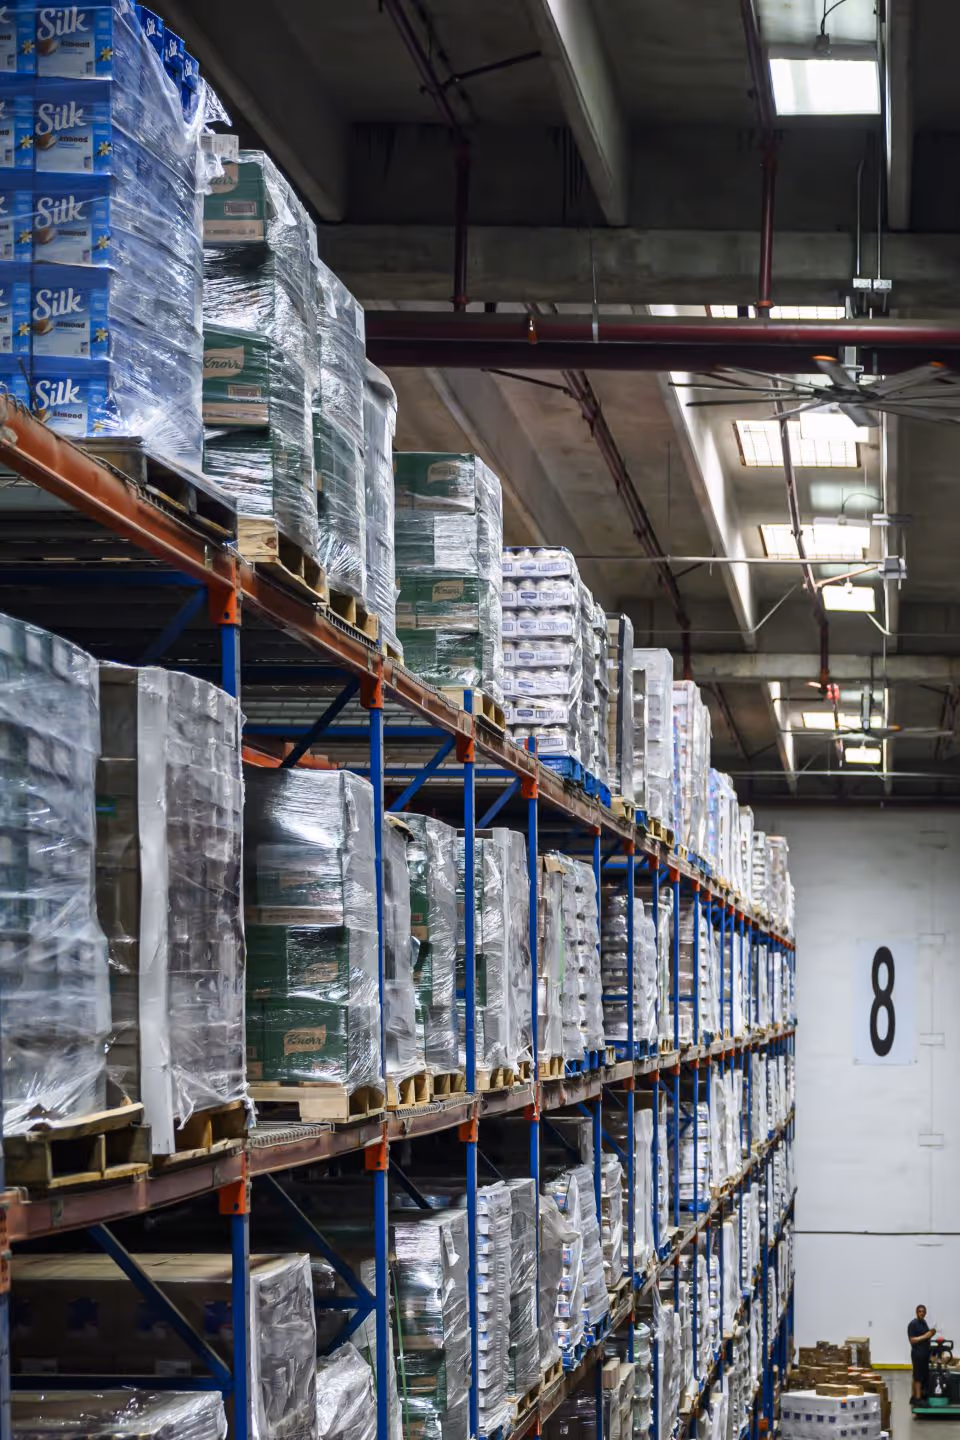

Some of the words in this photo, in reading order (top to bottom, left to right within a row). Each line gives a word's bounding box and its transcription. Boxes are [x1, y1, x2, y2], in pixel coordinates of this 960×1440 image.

[37, 6, 89, 41] Silk
[35, 101, 87, 136] Silk
[34, 195, 87, 229] Silk
[32, 287, 85, 321] Silk
[54, 321, 86, 329] Almond
[32, 378, 83, 411] Silk
[52, 411, 83, 420] Almond
[869, 946, 896, 1057] 8
[287, 1033, 322, 1046] Knorr
